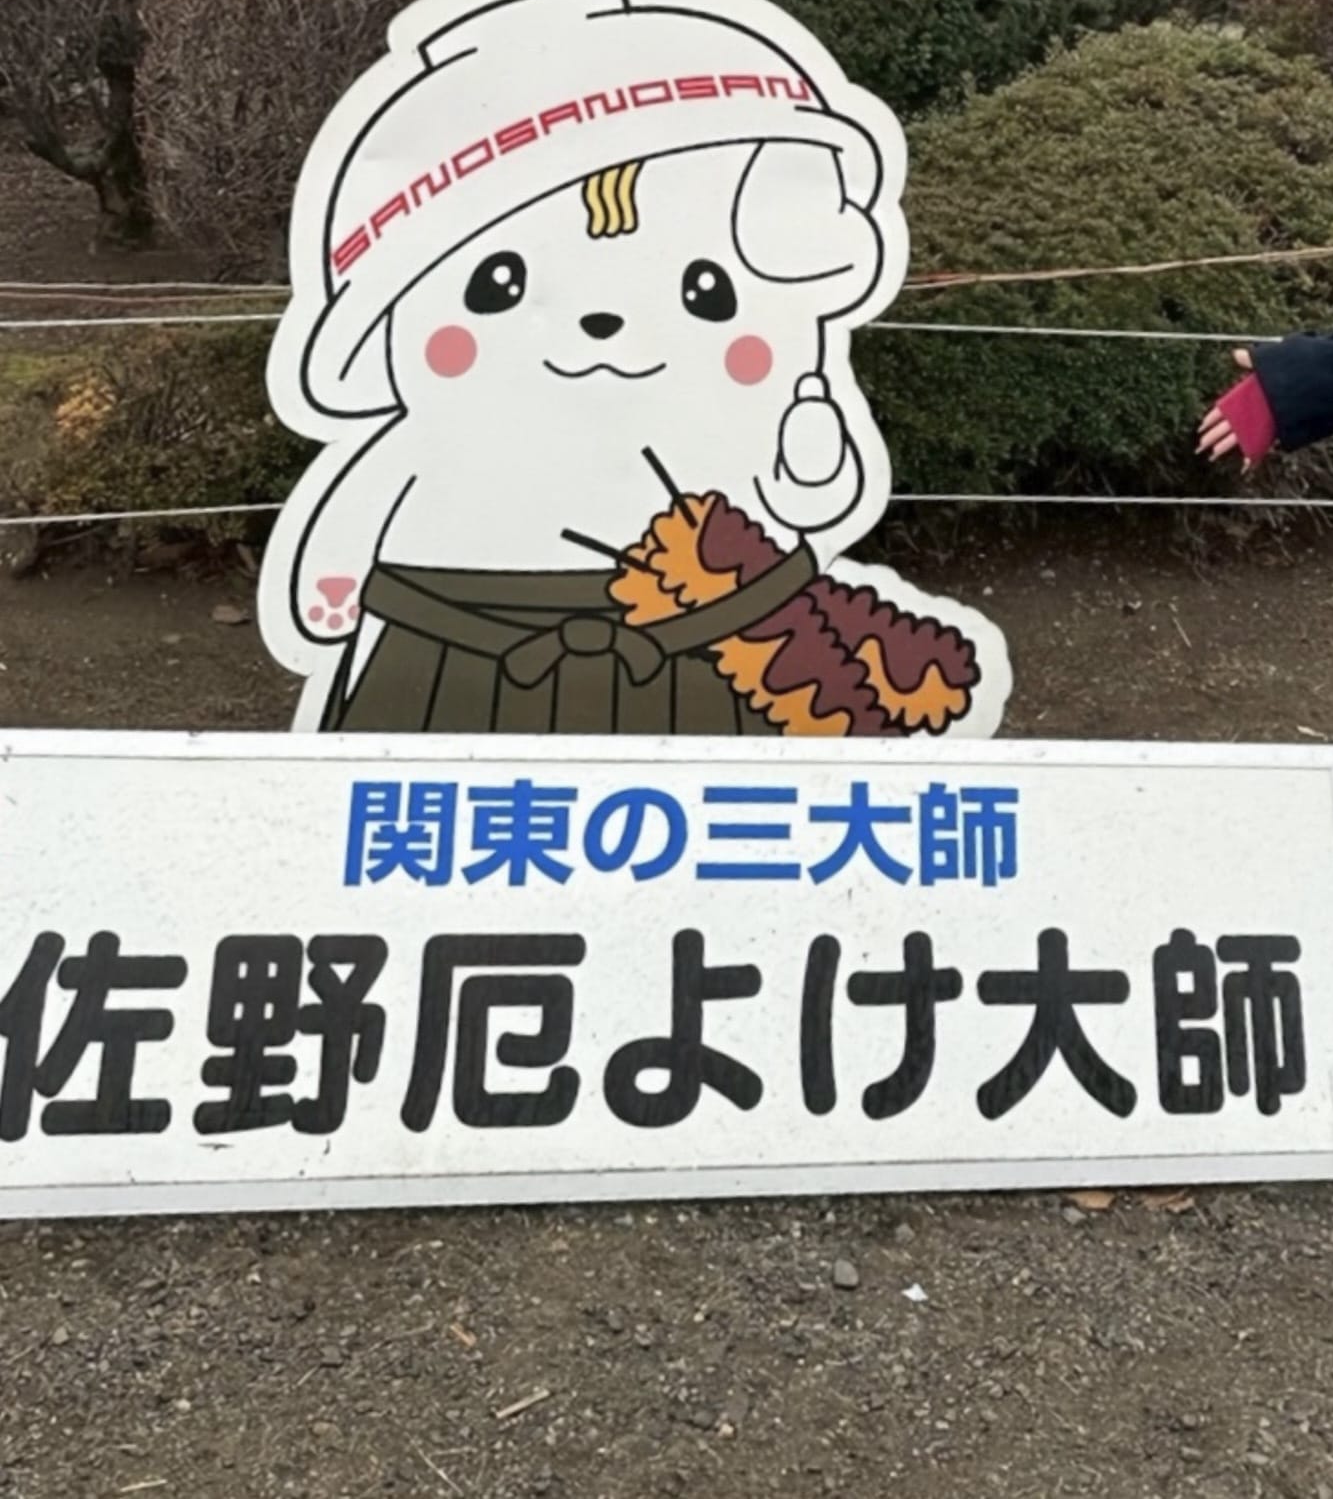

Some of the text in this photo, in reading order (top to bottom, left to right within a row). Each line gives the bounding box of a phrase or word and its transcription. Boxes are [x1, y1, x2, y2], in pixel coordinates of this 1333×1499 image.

[331, 75, 813, 275] SANOSANOSAN
[344, 779, 1018, 886] 関東の三大師
[0, 929, 1306, 1142] 佐野厄よけ大師
